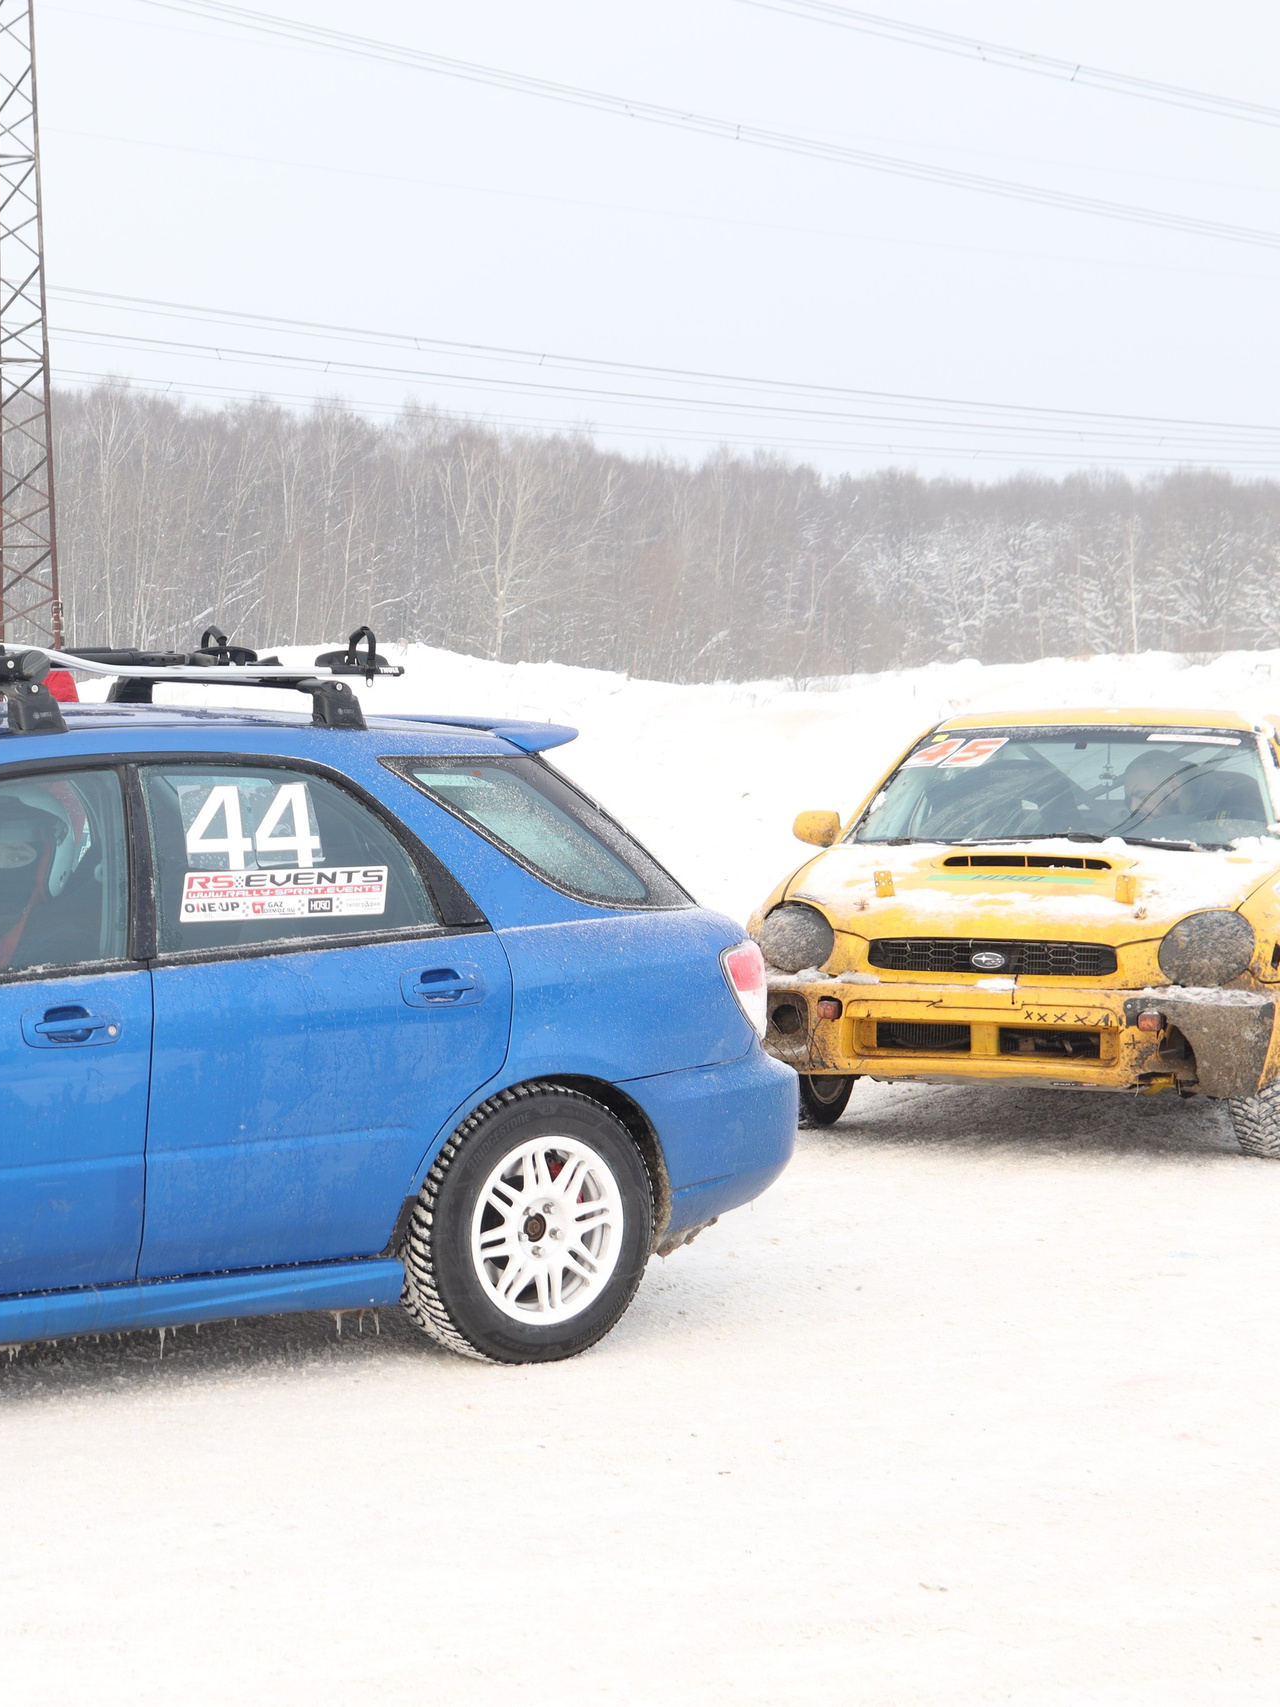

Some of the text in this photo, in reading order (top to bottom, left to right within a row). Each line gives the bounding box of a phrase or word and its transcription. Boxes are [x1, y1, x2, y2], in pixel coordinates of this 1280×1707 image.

[910, 738, 1006, 764] 45
[185, 783, 321, 870] 44
[187, 869, 384, 890] RS EVENTS
